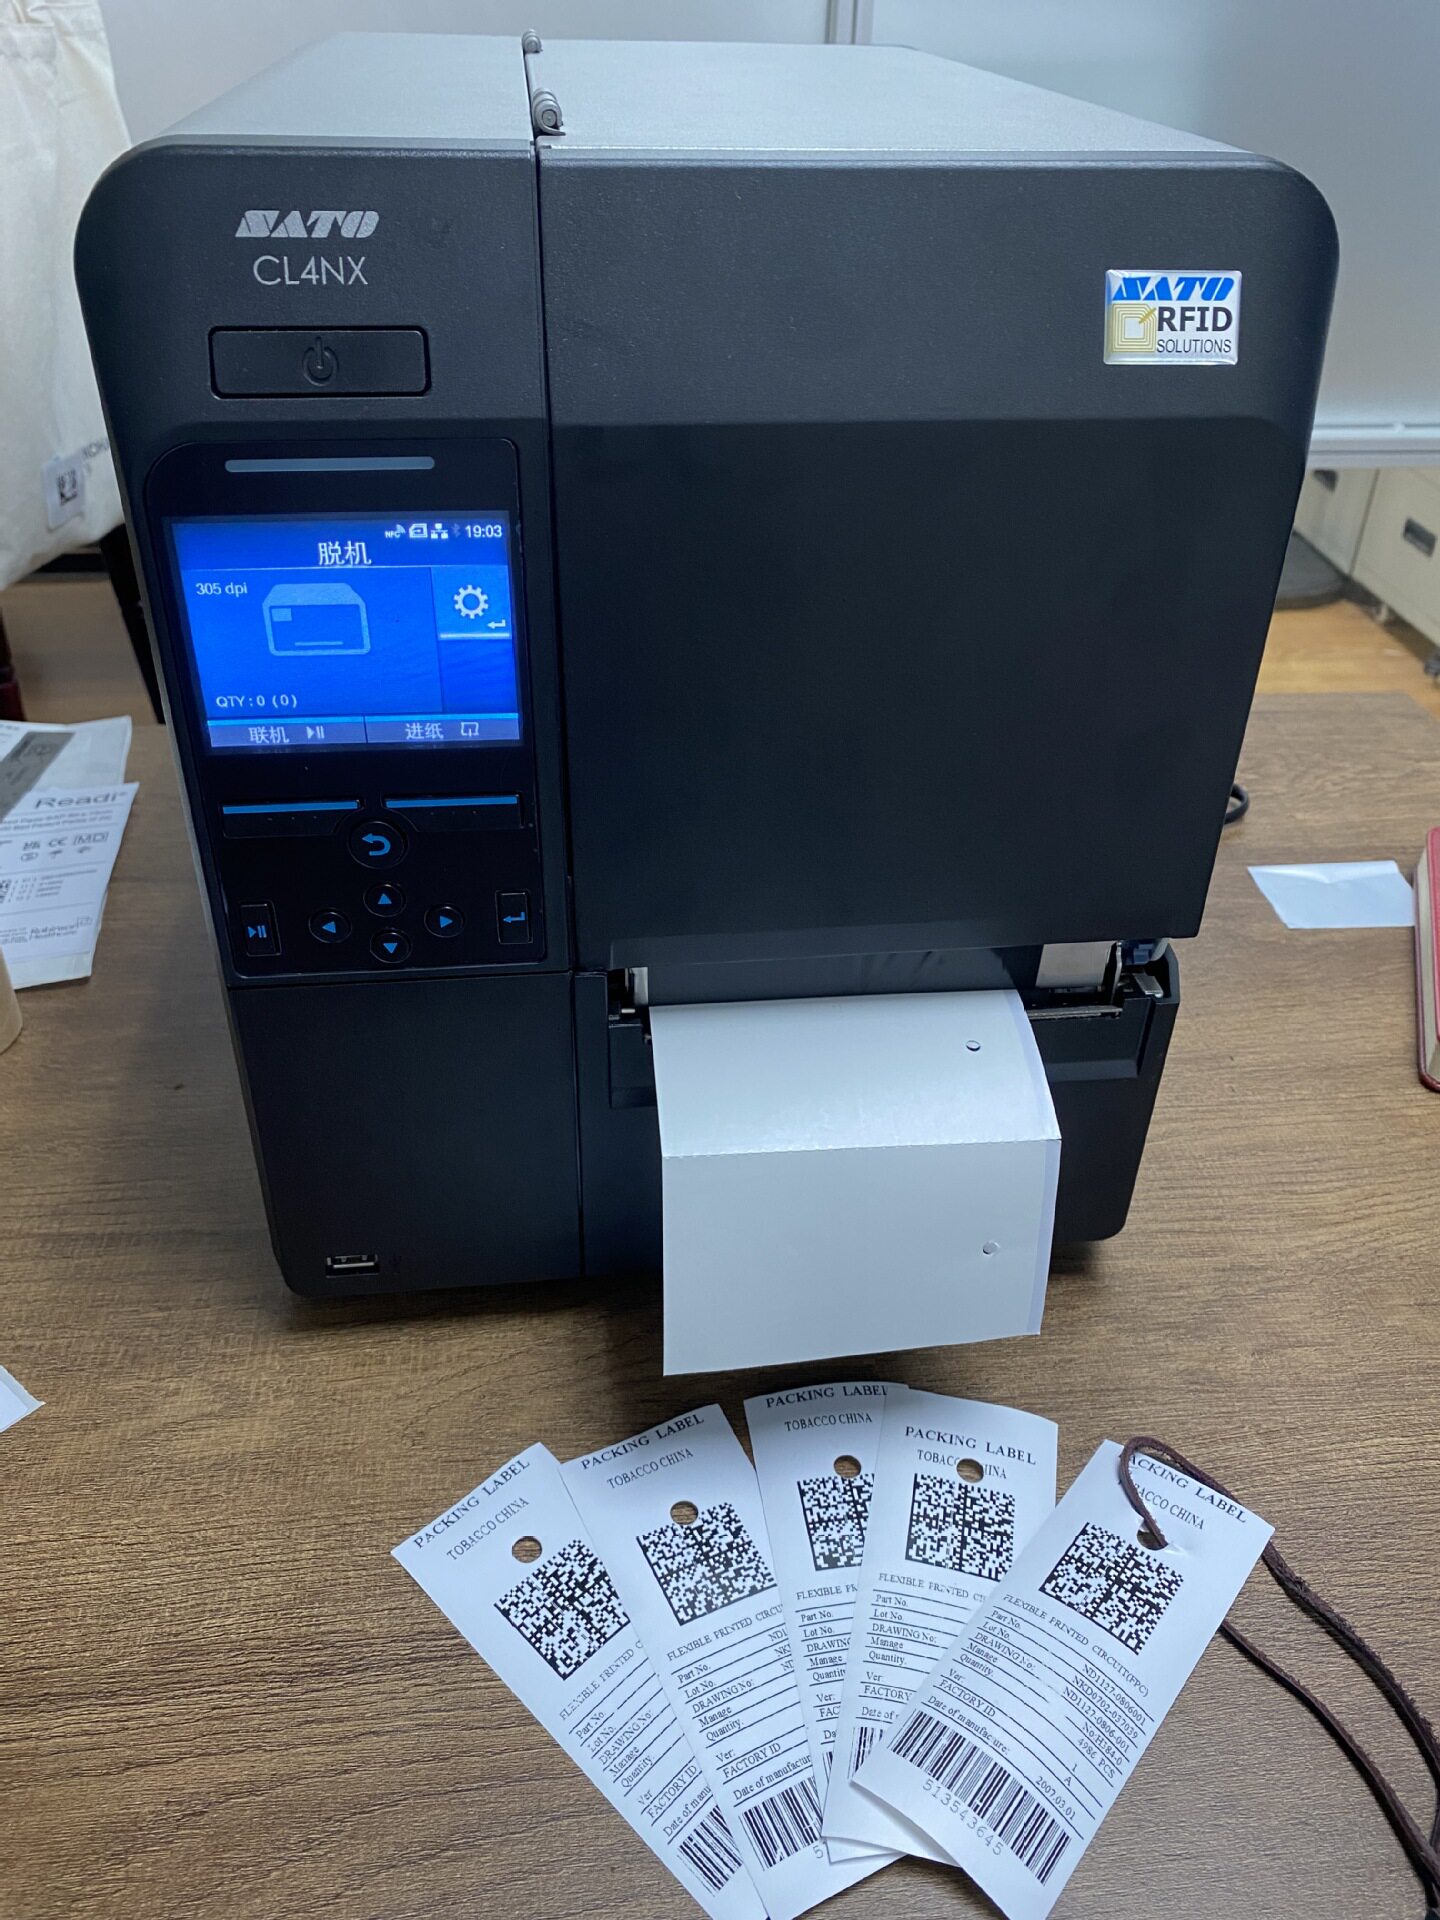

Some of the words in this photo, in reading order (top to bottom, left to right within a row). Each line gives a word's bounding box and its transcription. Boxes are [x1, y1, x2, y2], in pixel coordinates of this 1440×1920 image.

[234, 209, 380, 239] SATO
[252, 254, 369, 286] CL4NX
[1112, 276, 1235, 301] SATO
[1157, 306, 1233, 332] RFID
[1156, 338, 1232, 354] SOLUTIONS
[465, 524, 503, 539] 19:03
[317, 541, 372, 566] 脱机
[195, 582, 222, 596] 305
[225, 581, 248, 598] dpi
[249, 725, 290, 744] 联机
[405, 722, 444, 741] 进纸
[766, 1387, 835, 1408] PACKING
[784, 1414, 837, 1432] TOBACCO
[838, 1412, 873, 1424] CHINA
[581, 1435, 650, 1470] PACKING
[655, 1413, 704, 1440] LABEL
[904, 1425, 977, 1449] PACKING
[986, 1441, 1037, 1465] LABEL
[606, 1461, 659, 1489] TOBACCO
[659, 1447, 694, 1468] CHINA
[917, 1449, 960, 1466] TOBAC
[1129, 1454, 1189, 1489] ACKING
[1195, 1487, 1247, 1523] LABEL
[413, 1496, 480, 1549] PACKING
[482, 1460, 530, 1496] LABEL
[446, 1520, 497, 1560] TOBACCO
[495, 1497, 530, 1524] CHINA
[1169, 1504, 1204, 1530] CHINA
[879, 1572, 924, 1588] FLEXIBLE
[796, 1586, 843, 1600] FLEXIBLE
[876, 1594, 893, 1603] Part
[800, 1612, 817, 1623] Part
[873, 1609, 889, 1618] Lot
[1003, 1593, 1046, 1620] FLEXIBLE
[1049, 1616, 1090, 1646] PRINTED
[666, 1634, 713, 1661] FLEXIBLE
[713, 1617, 753, 1640] PRINTED
[803, 1628, 818, 1638] Lot
[872, 1623, 920, 1640] DRAWING
[983, 1621, 998, 1634] Lot
[870, 1636, 904, 1651] Manage
[967, 1641, 998, 1664] Manage
[974, 1632, 1021, 1661] DRAWING
[809, 1655, 842, 1667] Manage
[991, 1610, 1010, 1623] Part
[1083, 1664, 1147, 1727] ND1127-0806001
[677, 1669, 695, 1684] Part
[559, 1680, 600, 1720] FLEXIBLE
[685, 1685, 701, 1699] Lot
[692, 1683, 739, 1713] DRAWING
[863, 1685, 912, 1701] FACTORY
[699, 1705, 732, 1728] Manage
[861, 1706, 882, 1718] Date
[883, 1710, 895, 1720] of
[928, 1695, 947, 1712] Date
[947, 1706, 961, 1719] of
[575, 1722, 592, 1740] Part
[939, 1679, 985, 1710] FACTORY
[983, 1704, 997, 1718] ID
[1063, 1776, 1072, 1787] A
[587, 1735, 602, 1753] Lot
[599, 1722, 641, 1766] DRAWING
[609, 1746, 640, 1778] Manage
[722, 1748, 769, 1779] FACTORY
[769, 1742, 782, 1753] ID
[1098, 1758, 1115, 1780] PCS
[646, 1779, 687, 1820] FACTORY
[687, 1764, 698, 1781] ID
[733, 1783, 755, 1801] Date
[755, 1775, 767, 1788] of
[662, 1815, 684, 1838] Date
[682, 1803, 695, 1818] of
[922, 1778, 1005, 1856] 513543645
